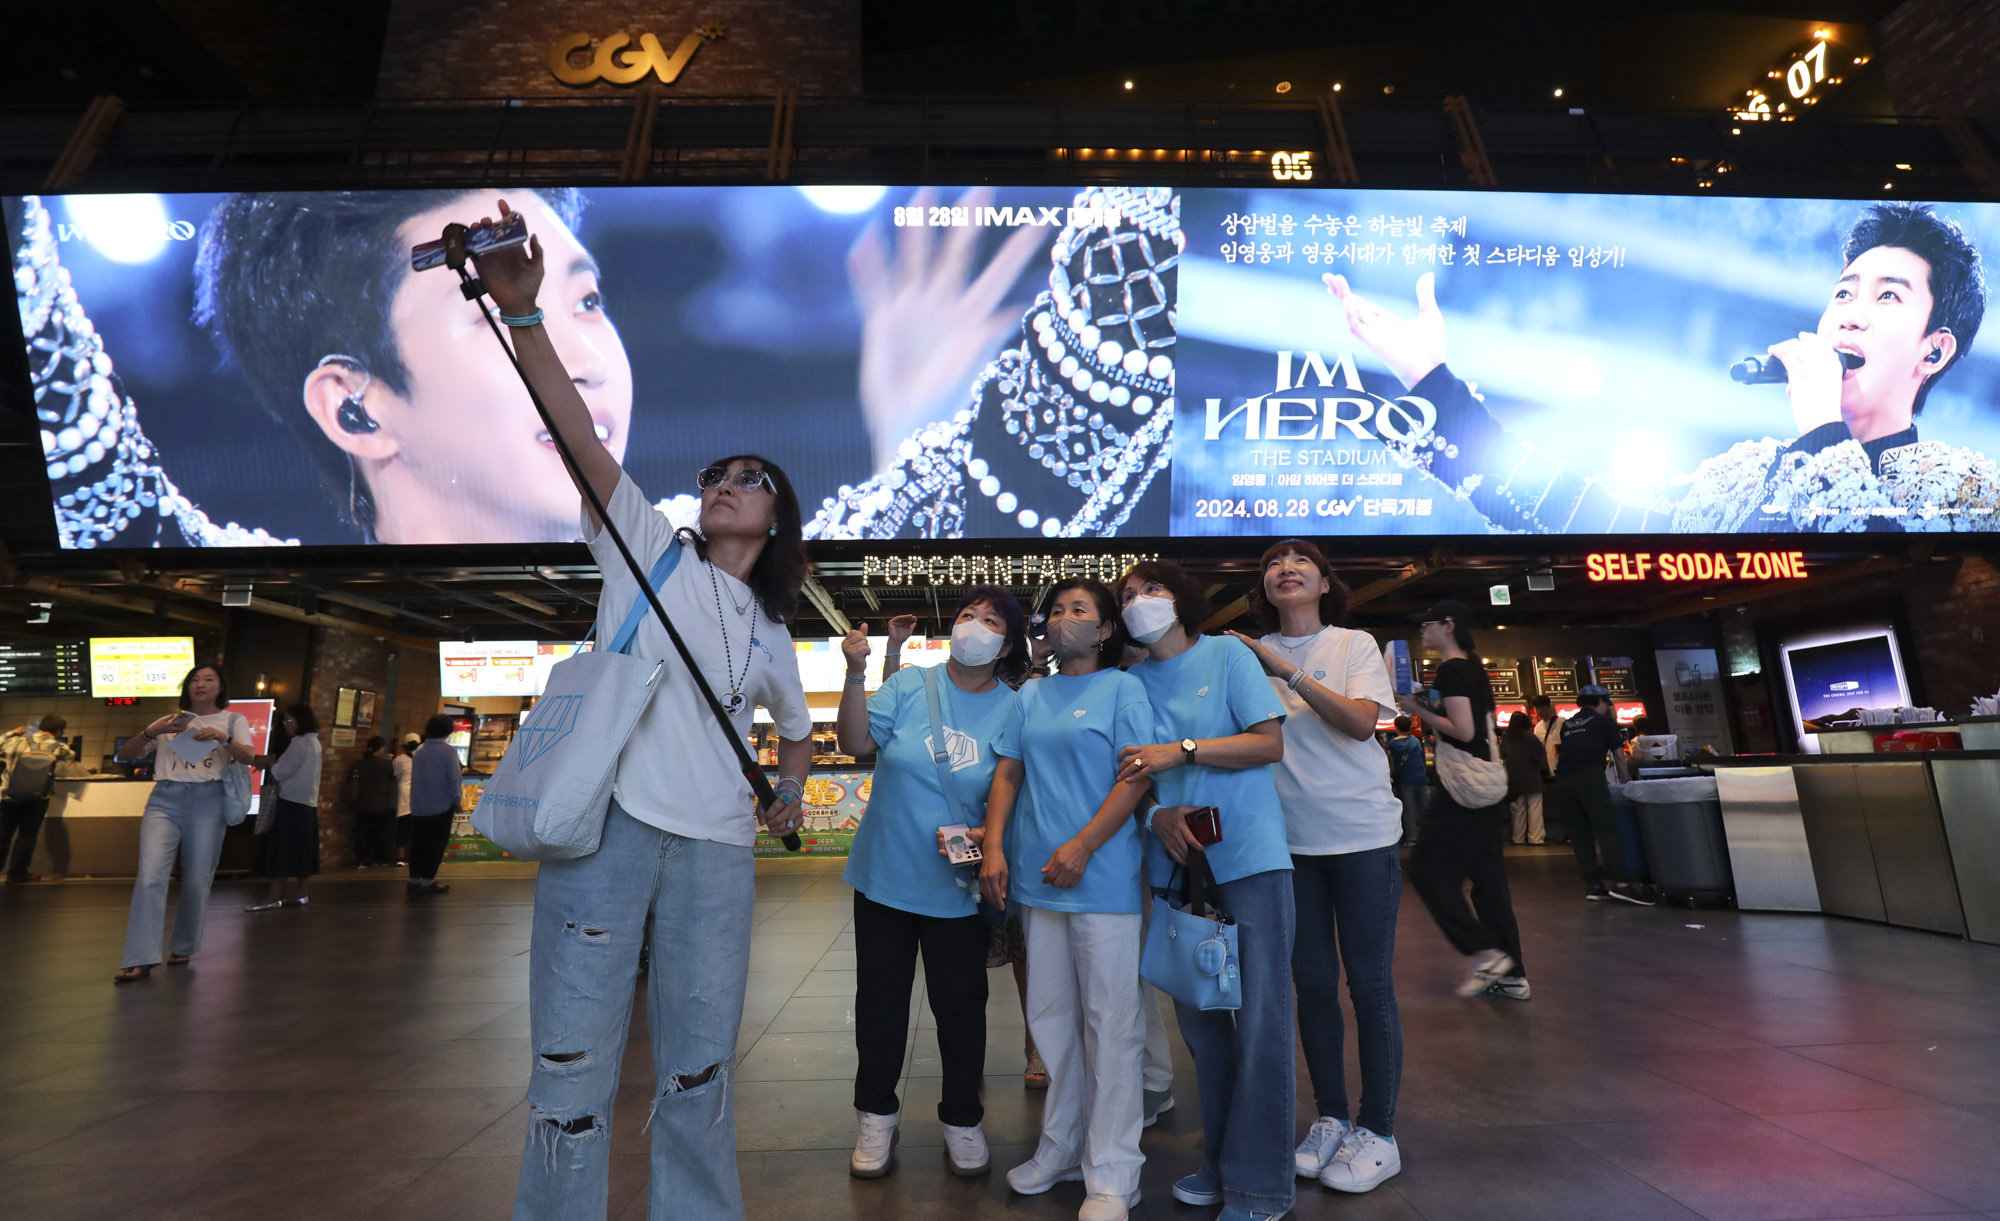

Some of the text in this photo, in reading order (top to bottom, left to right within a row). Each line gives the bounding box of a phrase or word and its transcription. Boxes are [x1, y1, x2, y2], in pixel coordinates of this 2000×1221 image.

[550, 32, 702, 85] CGV
[1787, 40, 1826, 99] 07
[1271, 152, 1313, 181] 05
[893, 206, 924, 227] 8월
[928, 206, 969, 227] 28일
[975, 206, 1062, 227] IMAX
[1220, 212, 1467, 238] 상암벌을 수놓은 하늘빛 축제
[1220, 241, 1626, 268] 임영웅과 영웅시대가 함께한 첫 스타디움 입성기!
[1275, 350, 1366, 393] IM
[1204, 393, 1438, 442] HERO
[1250, 449, 1388, 466] THE STADIUM
[1232, 473, 1403, 487] 임영웅 아임 히어로 더 스타디움
[1316, 499, 1358, 517] CGV
[1363, 498, 1433, 517] 단독개봉
[862, 555, 1013, 586] POPCORN
[1586, 551, 1808, 582] SELF SODA ZONE
[101, 674, 114, 683] 90
[146, 673, 167, 683] 1319
